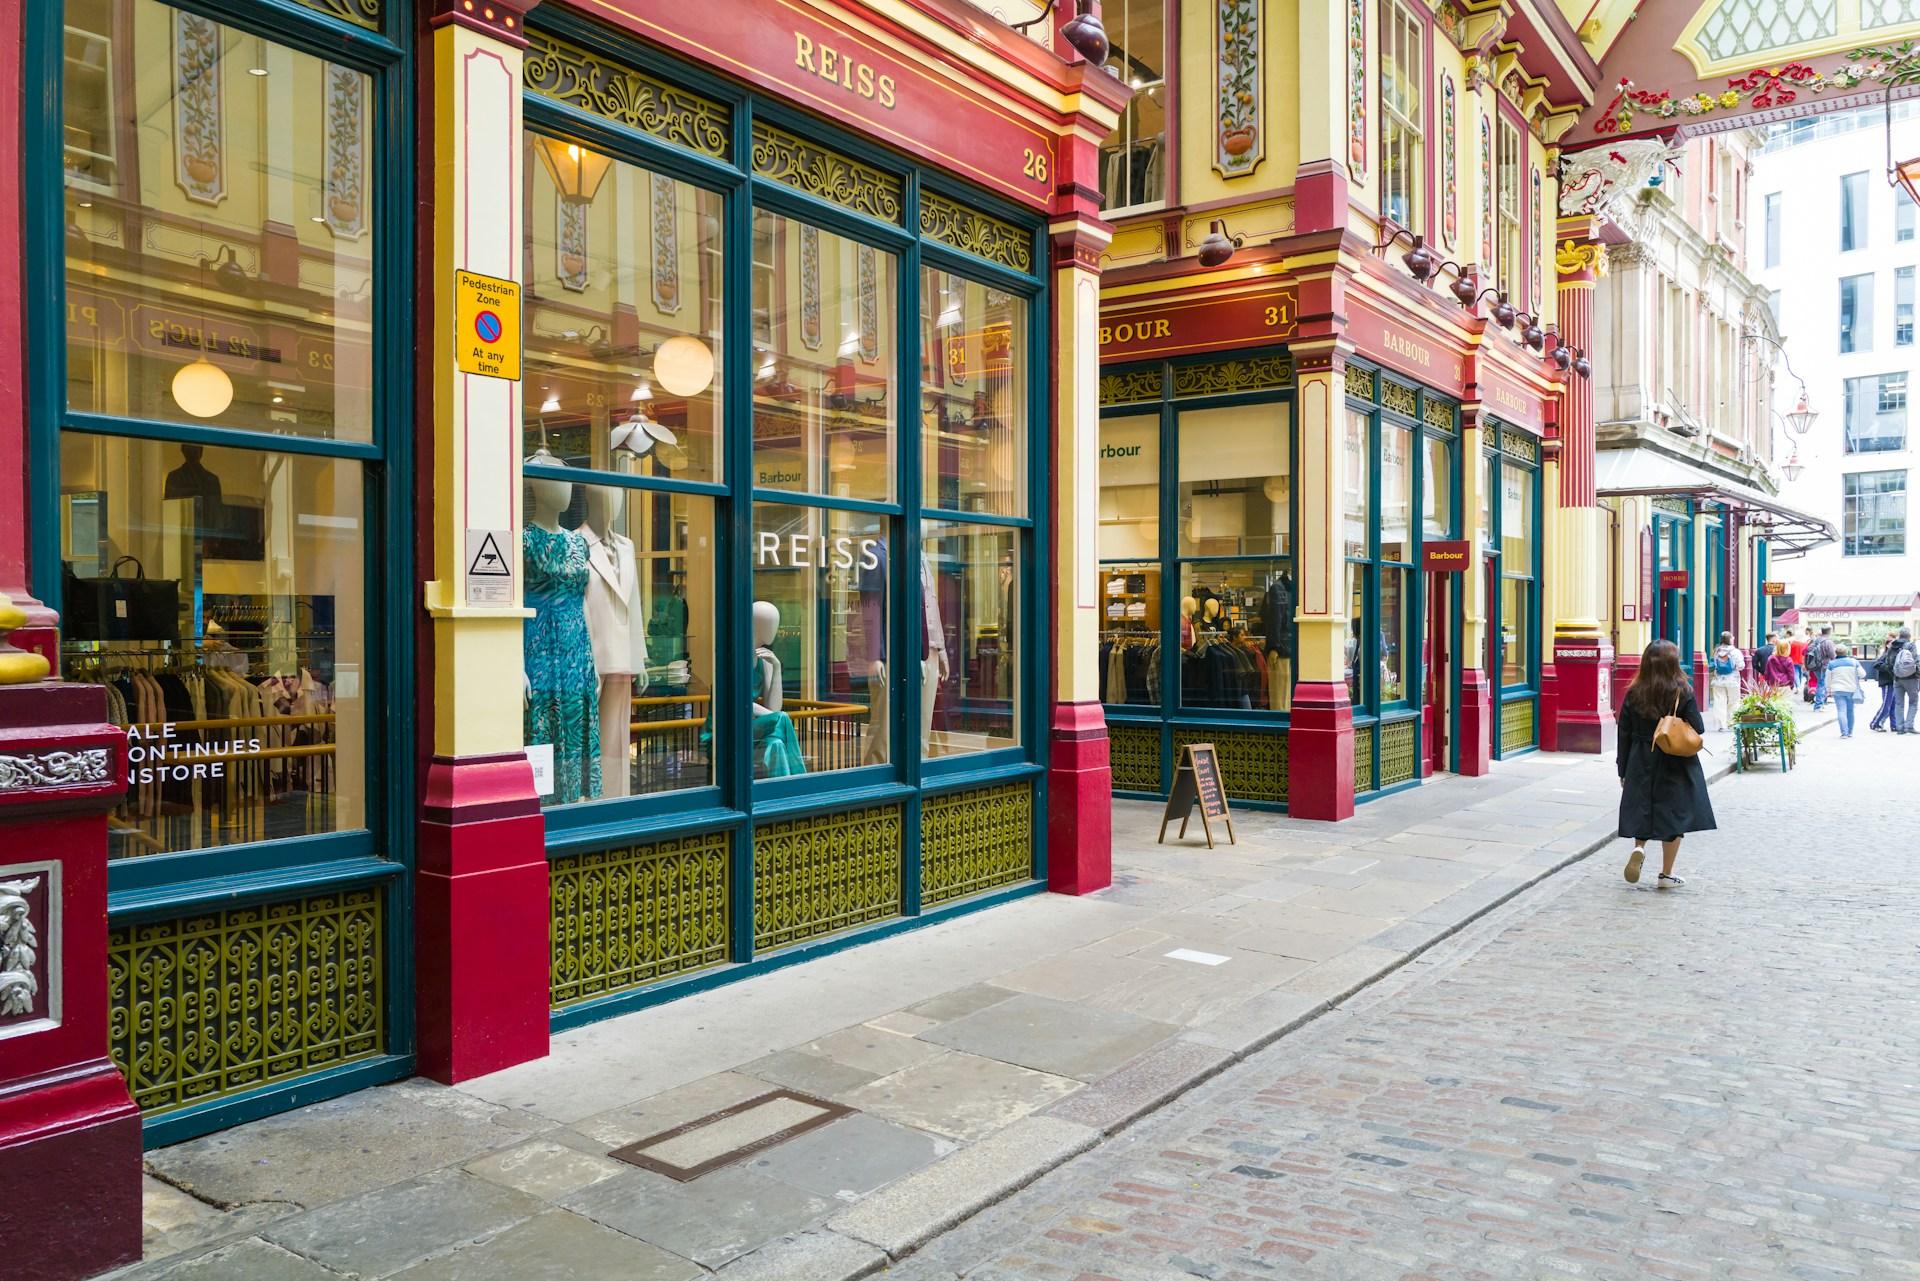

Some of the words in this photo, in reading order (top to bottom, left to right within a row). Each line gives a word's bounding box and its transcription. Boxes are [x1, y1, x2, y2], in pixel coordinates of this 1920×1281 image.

[794, 32, 896, 109] REISS
[1023, 148, 1048, 182] 26
[462, 276, 514, 296] Pedestrian
[476, 292, 501, 307] Zone
[1264, 305, 1289, 326] 31
[472, 347, 484, 359] At
[487, 351, 505, 364] any
[1383, 330, 1430, 367] BARBOUR
[478, 361, 500, 374] time
[1496, 387, 1527, 416] BARBOUR
[1100, 443, 1142, 458] rbour
[759, 470, 802, 484] Barbour
[759, 531, 879, 571] REISS
[1430, 551, 1464, 560] Barbour
[1808, 610, 1850, 619] GIORGIO
